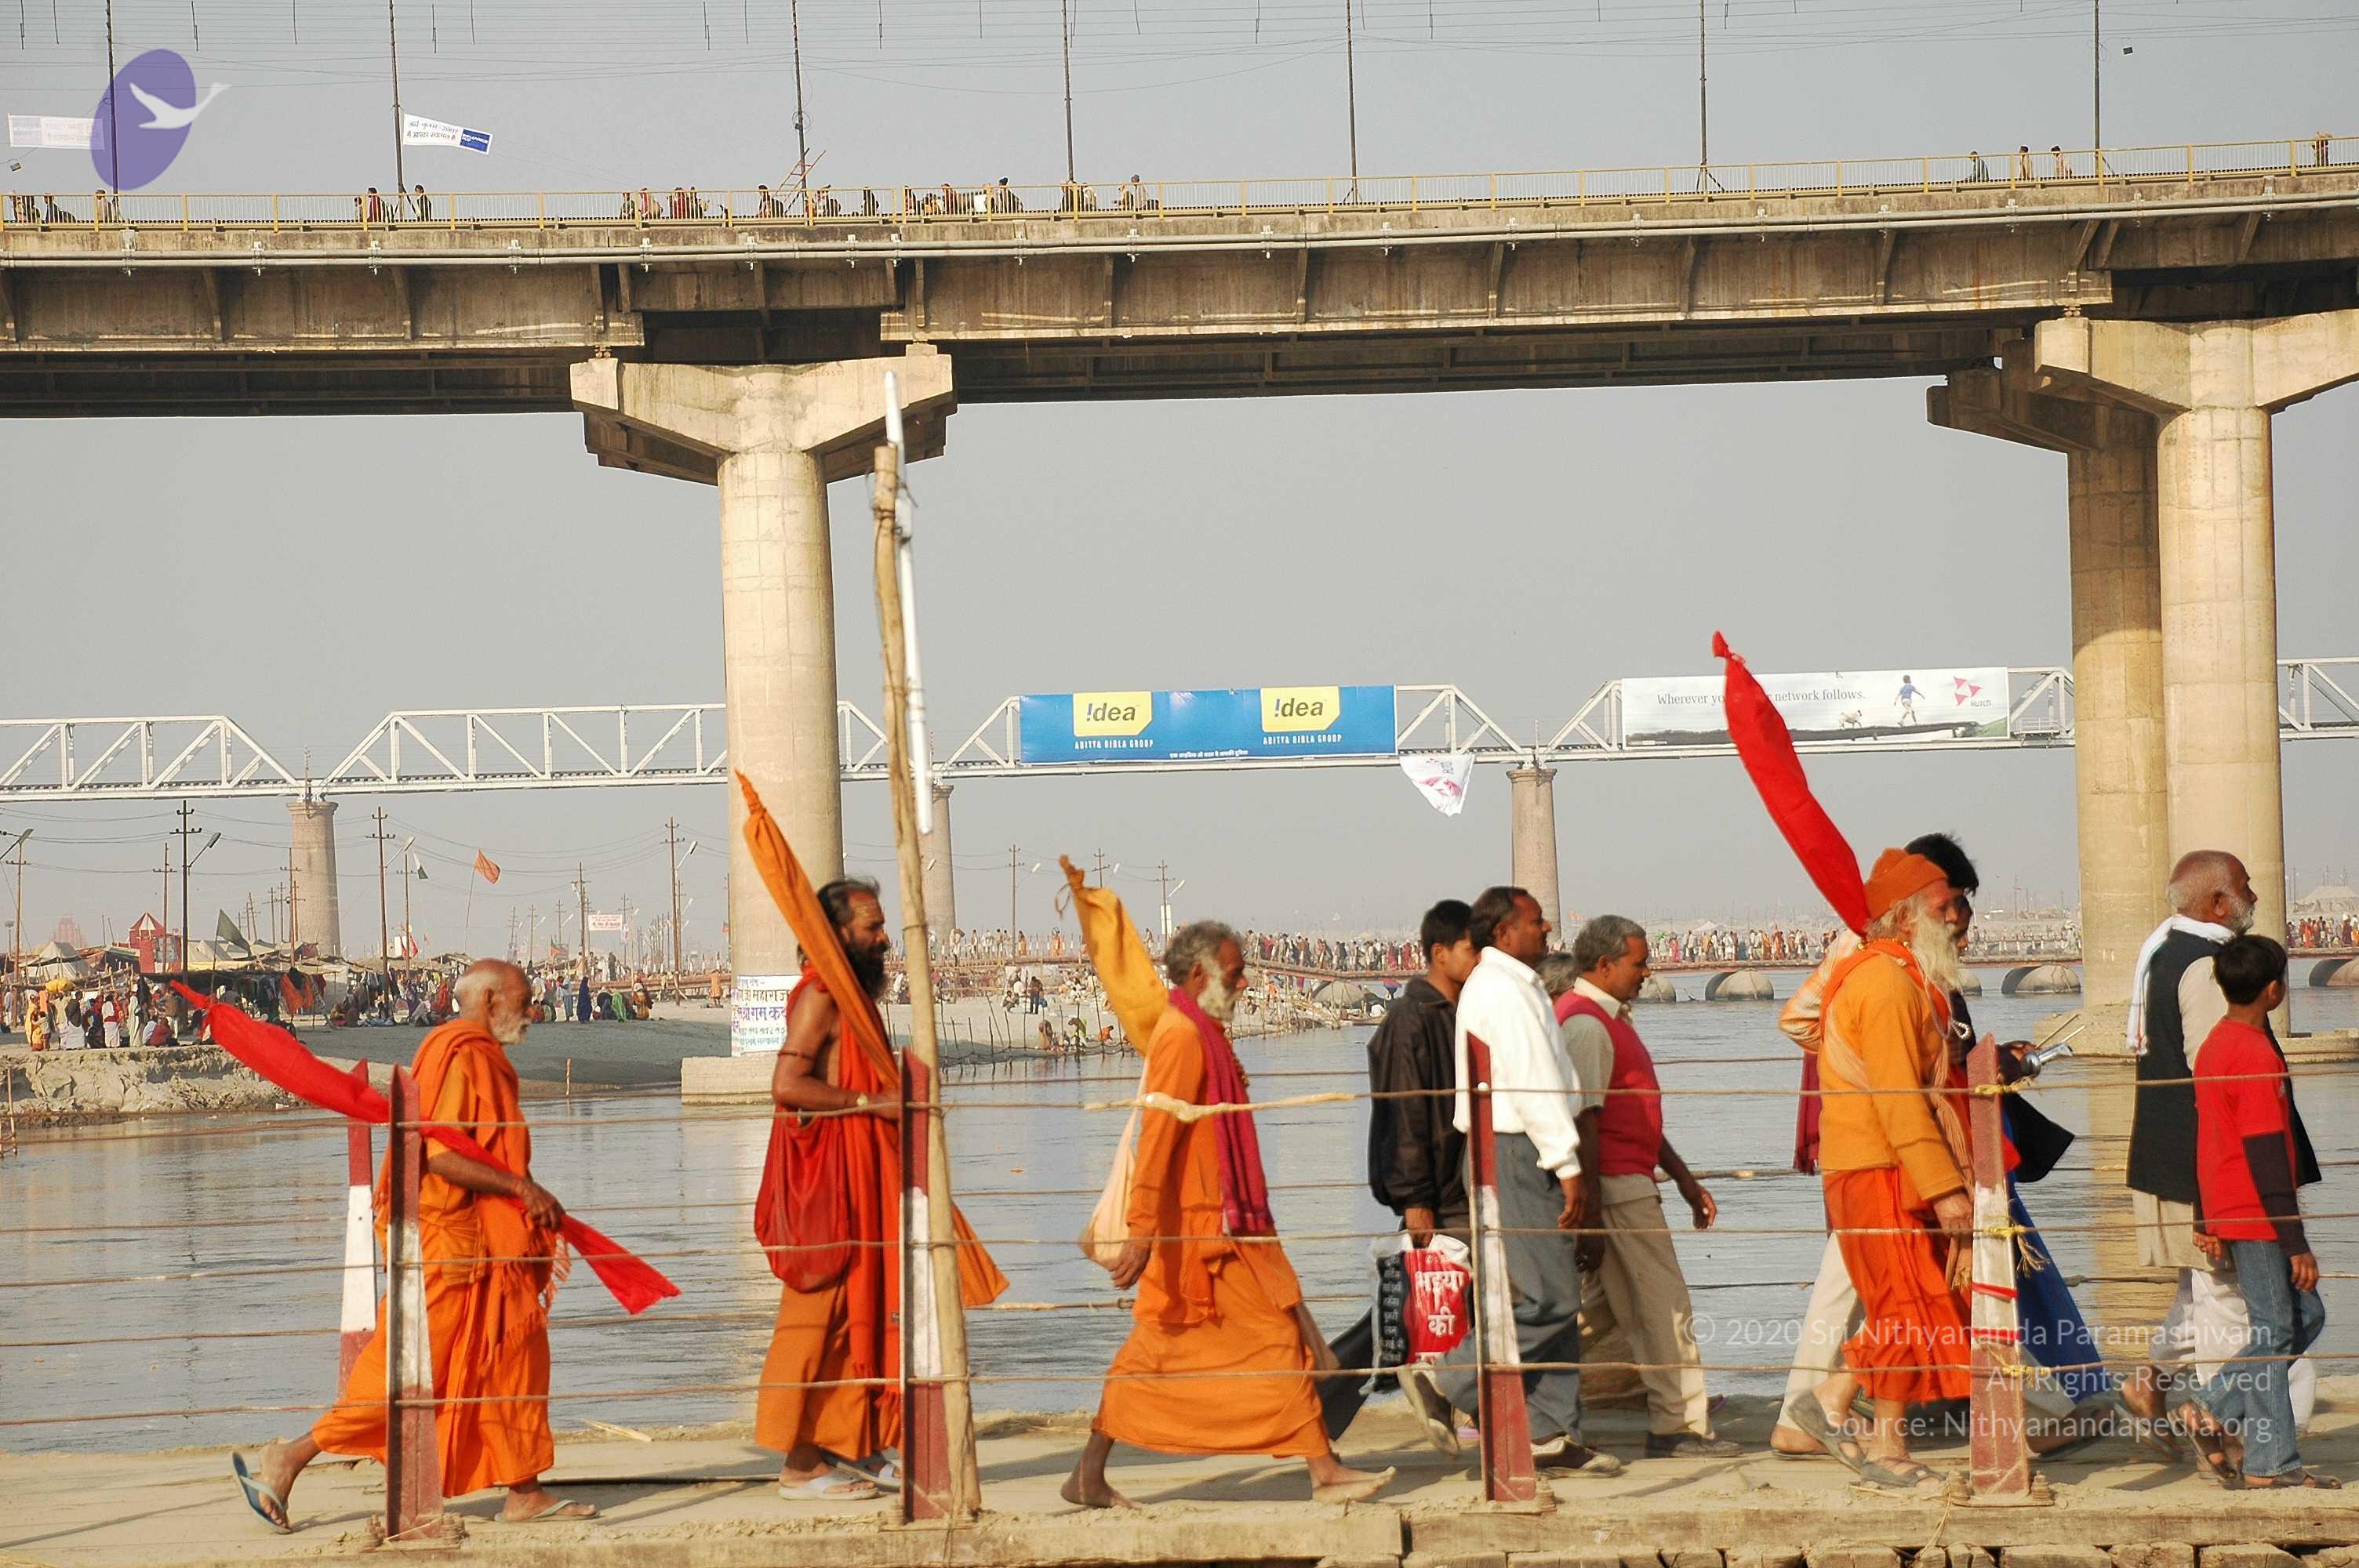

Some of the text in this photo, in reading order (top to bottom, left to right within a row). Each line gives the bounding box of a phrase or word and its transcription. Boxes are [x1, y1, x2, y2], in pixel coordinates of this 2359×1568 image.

[1656, 693, 1725, 706] Wherever yo
[1775, 692, 1819, 702] network
[1823, 689, 1866, 699] follows.
[1074, 740, 1101, 750] ADITYA
[1129, 739, 1154, 748] GROUP
[1263, 735, 1290, 745] ADITYA
[1318, 733, 1343, 743] GROUP
[1427, 1305, 1456, 1337] की
